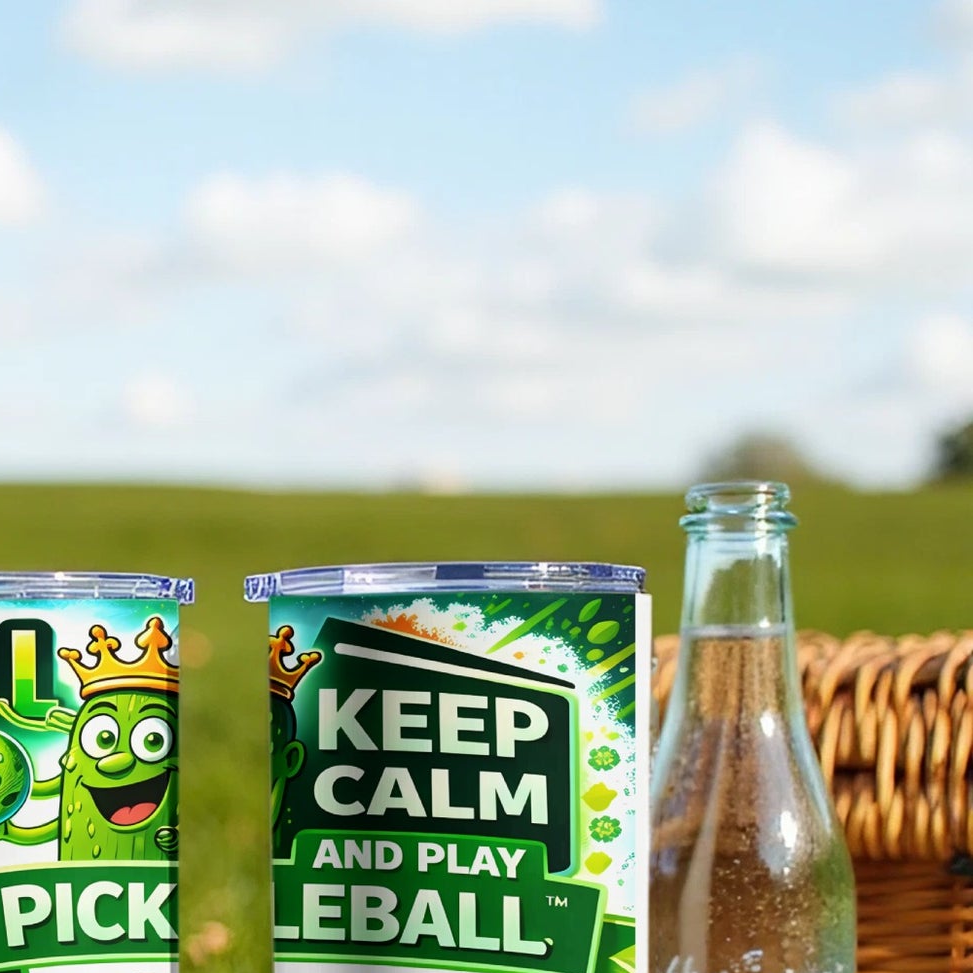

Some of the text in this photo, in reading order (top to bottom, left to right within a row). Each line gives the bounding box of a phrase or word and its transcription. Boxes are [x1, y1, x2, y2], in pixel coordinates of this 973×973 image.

[318, 688, 549, 758] KEEP
[313, 765, 549, 825] CALM
[312, 839, 526, 879] AND PLAY
[0, 881, 179, 947] PICK
